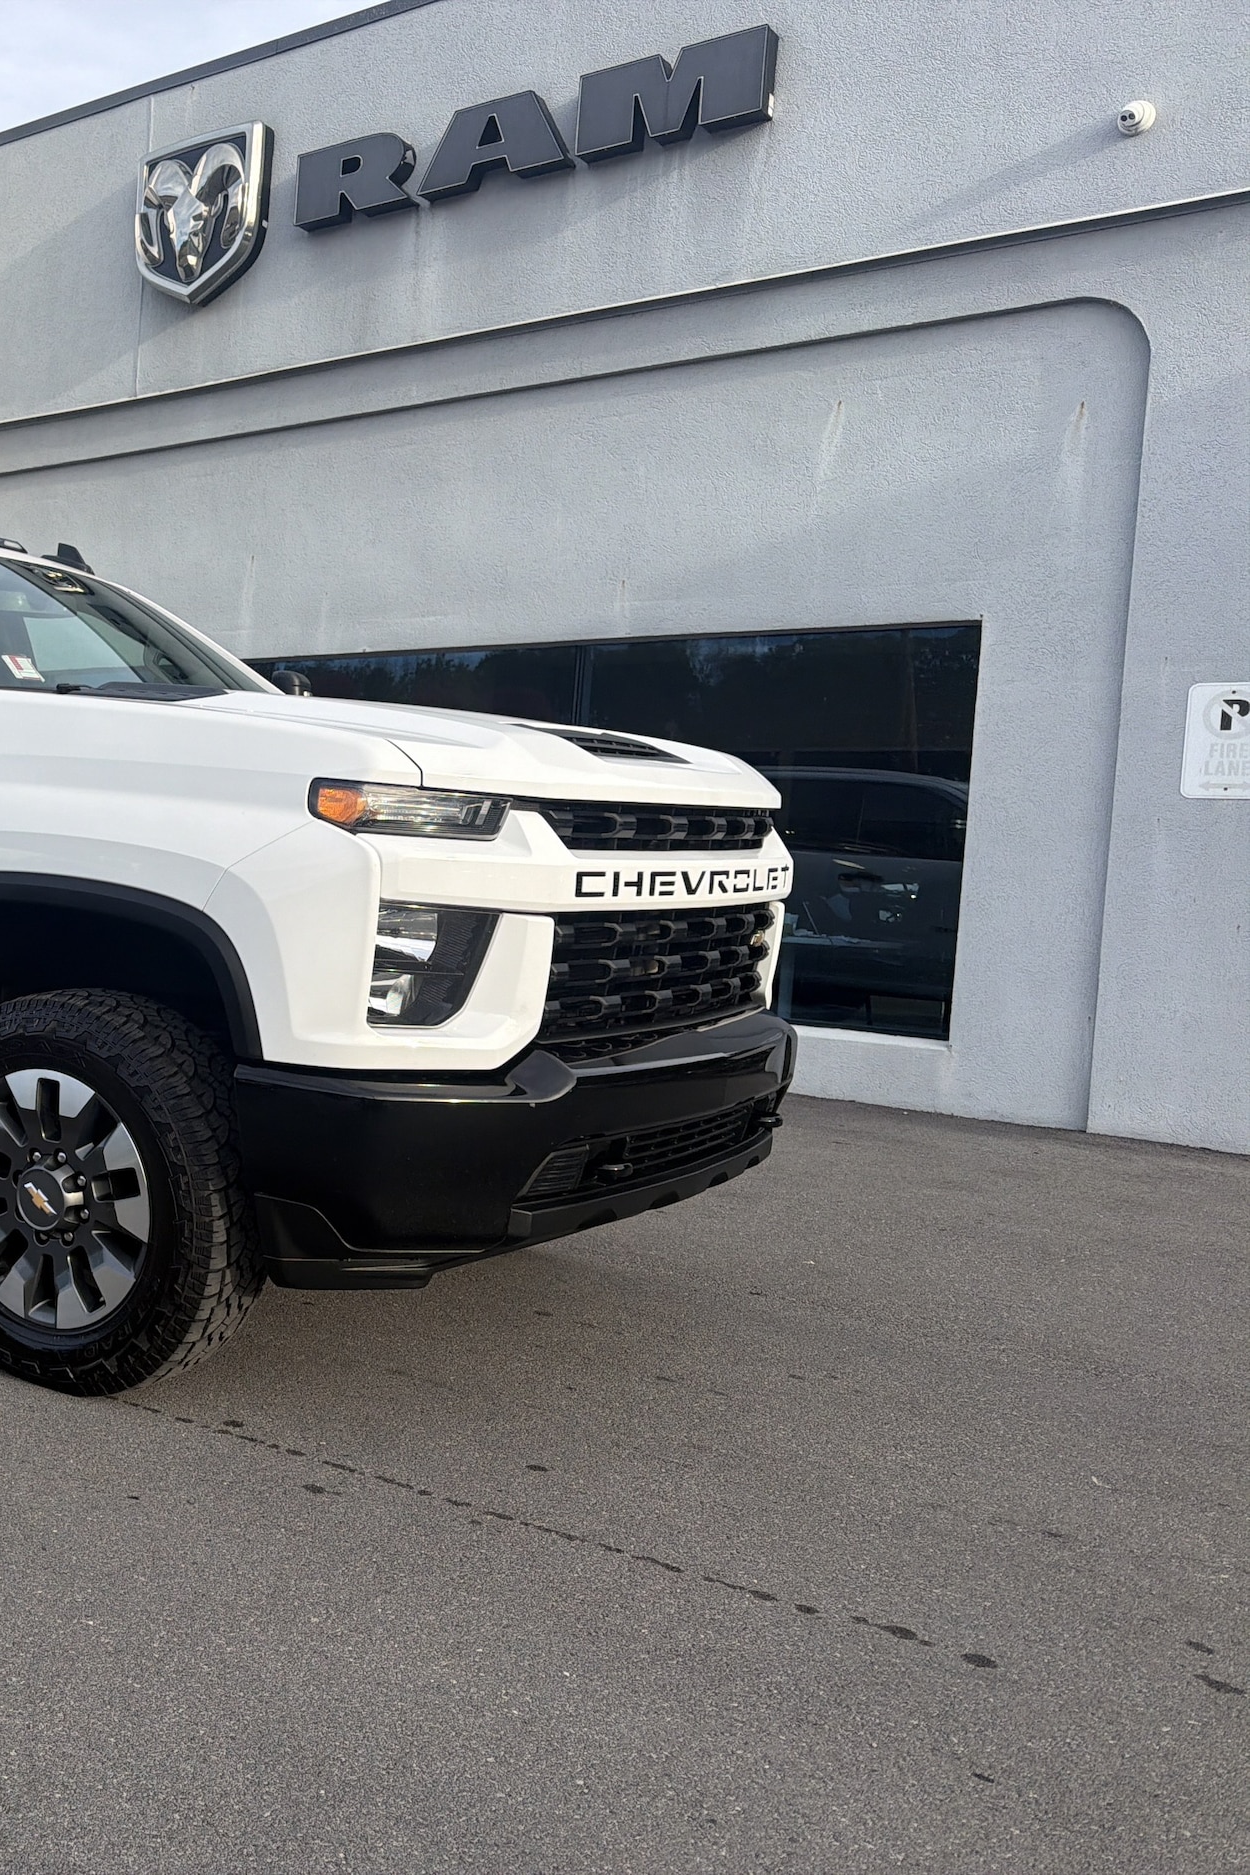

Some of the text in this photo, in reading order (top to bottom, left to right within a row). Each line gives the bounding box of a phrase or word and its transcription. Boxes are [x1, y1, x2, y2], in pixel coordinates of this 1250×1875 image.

[294, 24, 779, 231] RAM
[1209, 742, 1250, 759] FIRE
[1203, 760, 1250, 776] LANE
[575, 864, 790, 898] CHEVROLET
